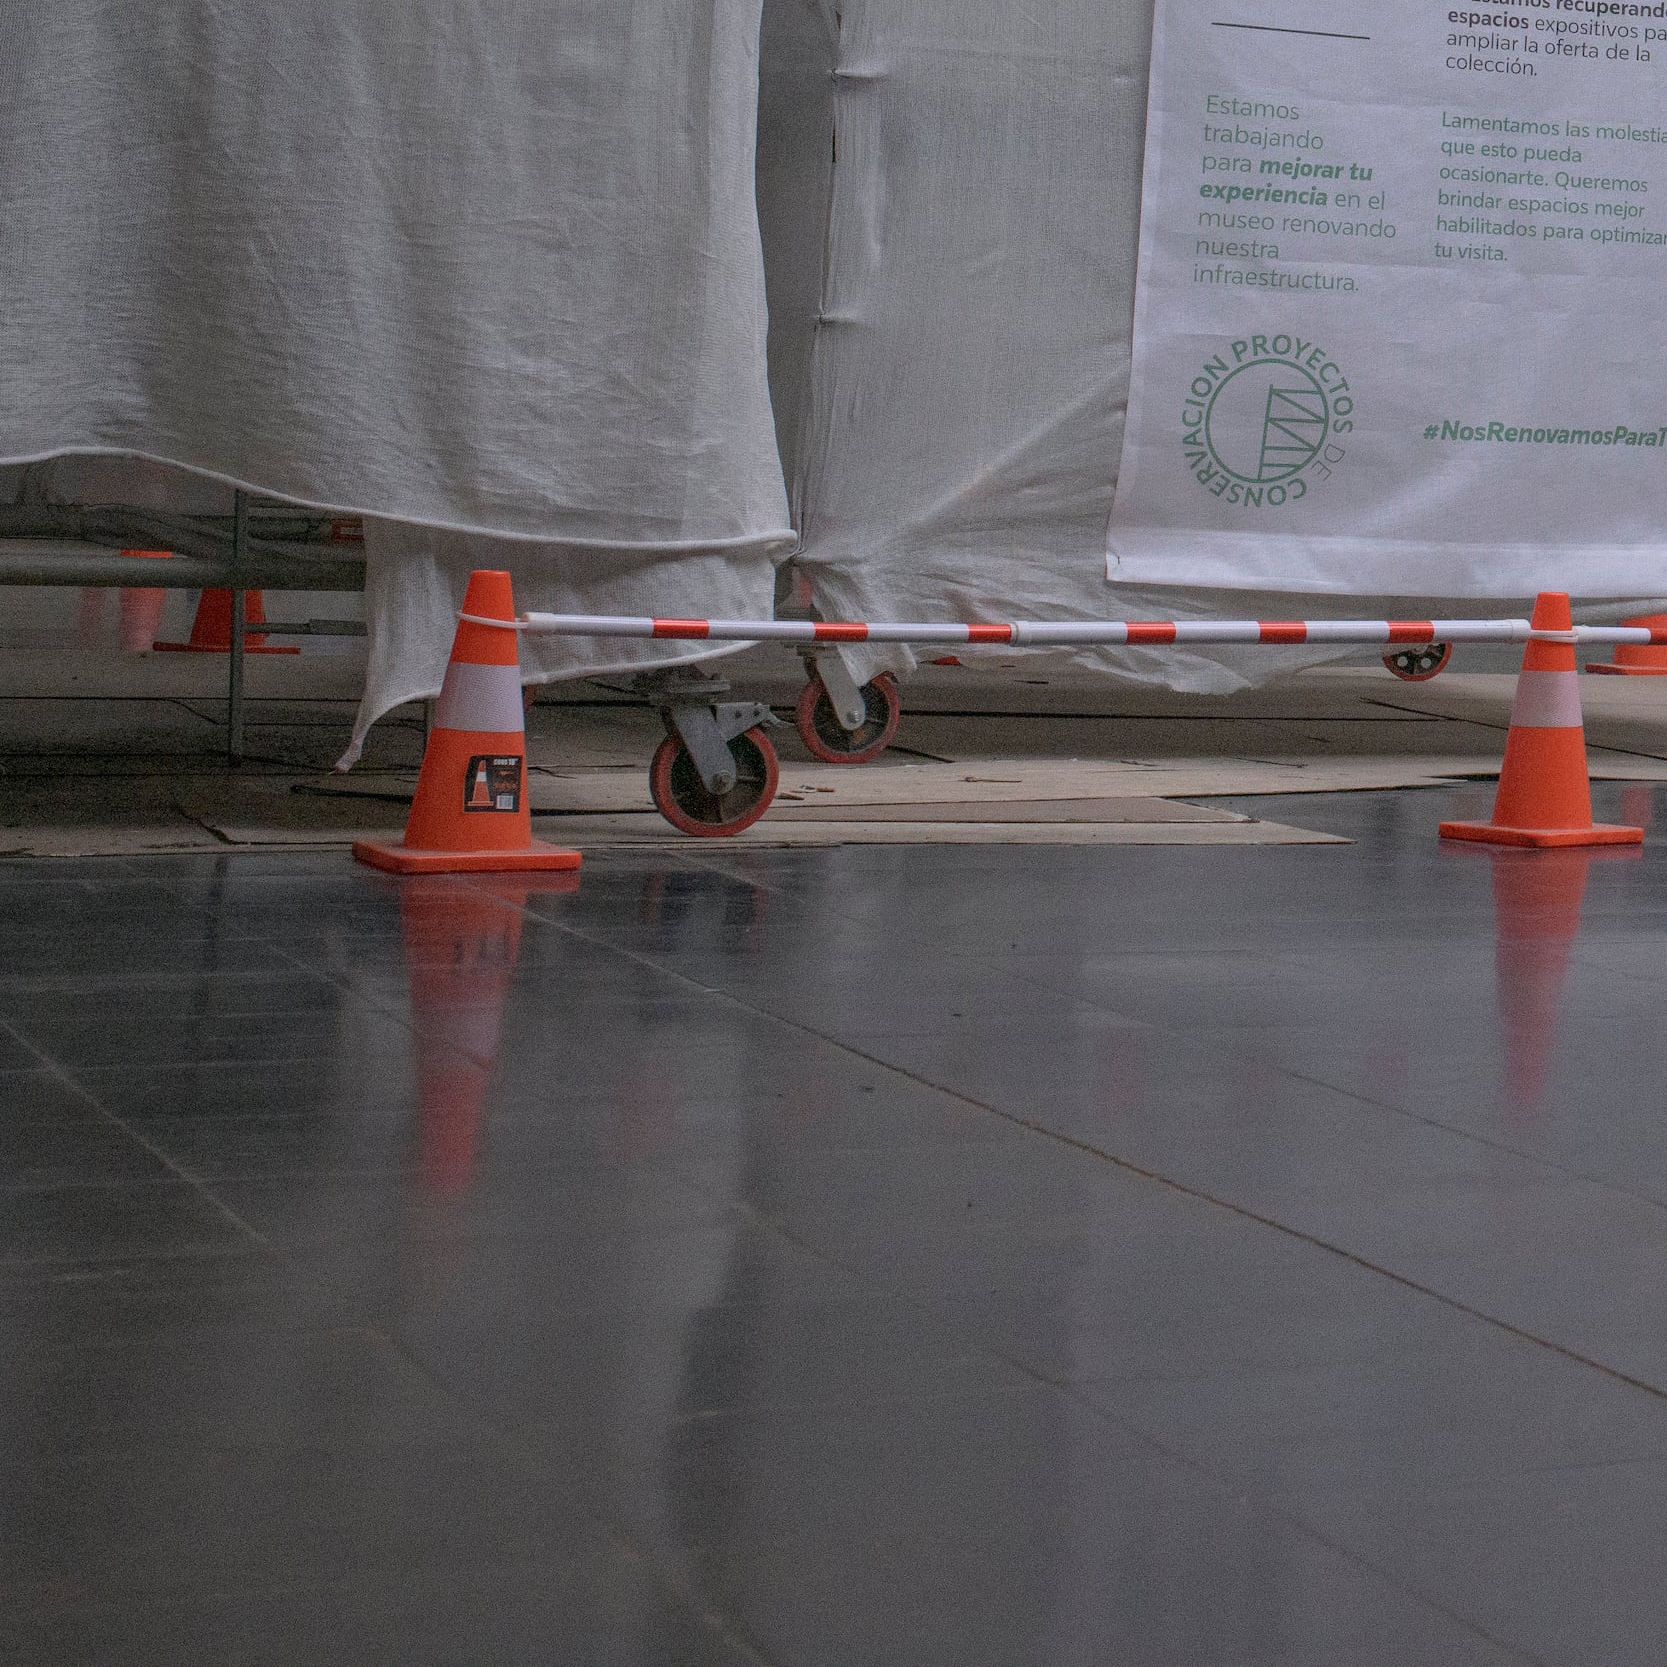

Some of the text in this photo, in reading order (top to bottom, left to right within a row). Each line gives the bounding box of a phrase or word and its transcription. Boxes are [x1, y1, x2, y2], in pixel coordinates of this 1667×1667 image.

[1448, 10, 1529, 30] espacios
[1535, 19, 1638, 39] expositivos
[1447, 33, 1650, 61] ampliar la oferta de la
[1446, 54, 1537, 76] colección.
[1206, 95, 1299, 120] Estamos
[1204, 124, 1324, 150] trabajando
[1442, 111, 1560, 136] Lamentamos
[1566, 120, 1590, 138] las
[1441, 140, 1582, 162] que esto pueda
[1202, 155, 1372, 181] para mejorar tu
[1439, 166, 1648, 192] ocasionarte. Queremos
[1200, 183, 1385, 210] experiencia en el
[1438, 189, 1645, 220] brindar espacios mejor
[1198, 212, 1396, 238] museo renovando
[1436, 215, 1537, 237] habilitados
[1543, 226, 1583, 241] para
[1196, 239, 1279, 259] nuestra
[1434, 242, 1508, 261] tu visita.
[1193, 263, 1359, 291] infraestructura.
[1182, 334, 1353, 508] PROYECTOS DE CONSERVACION
